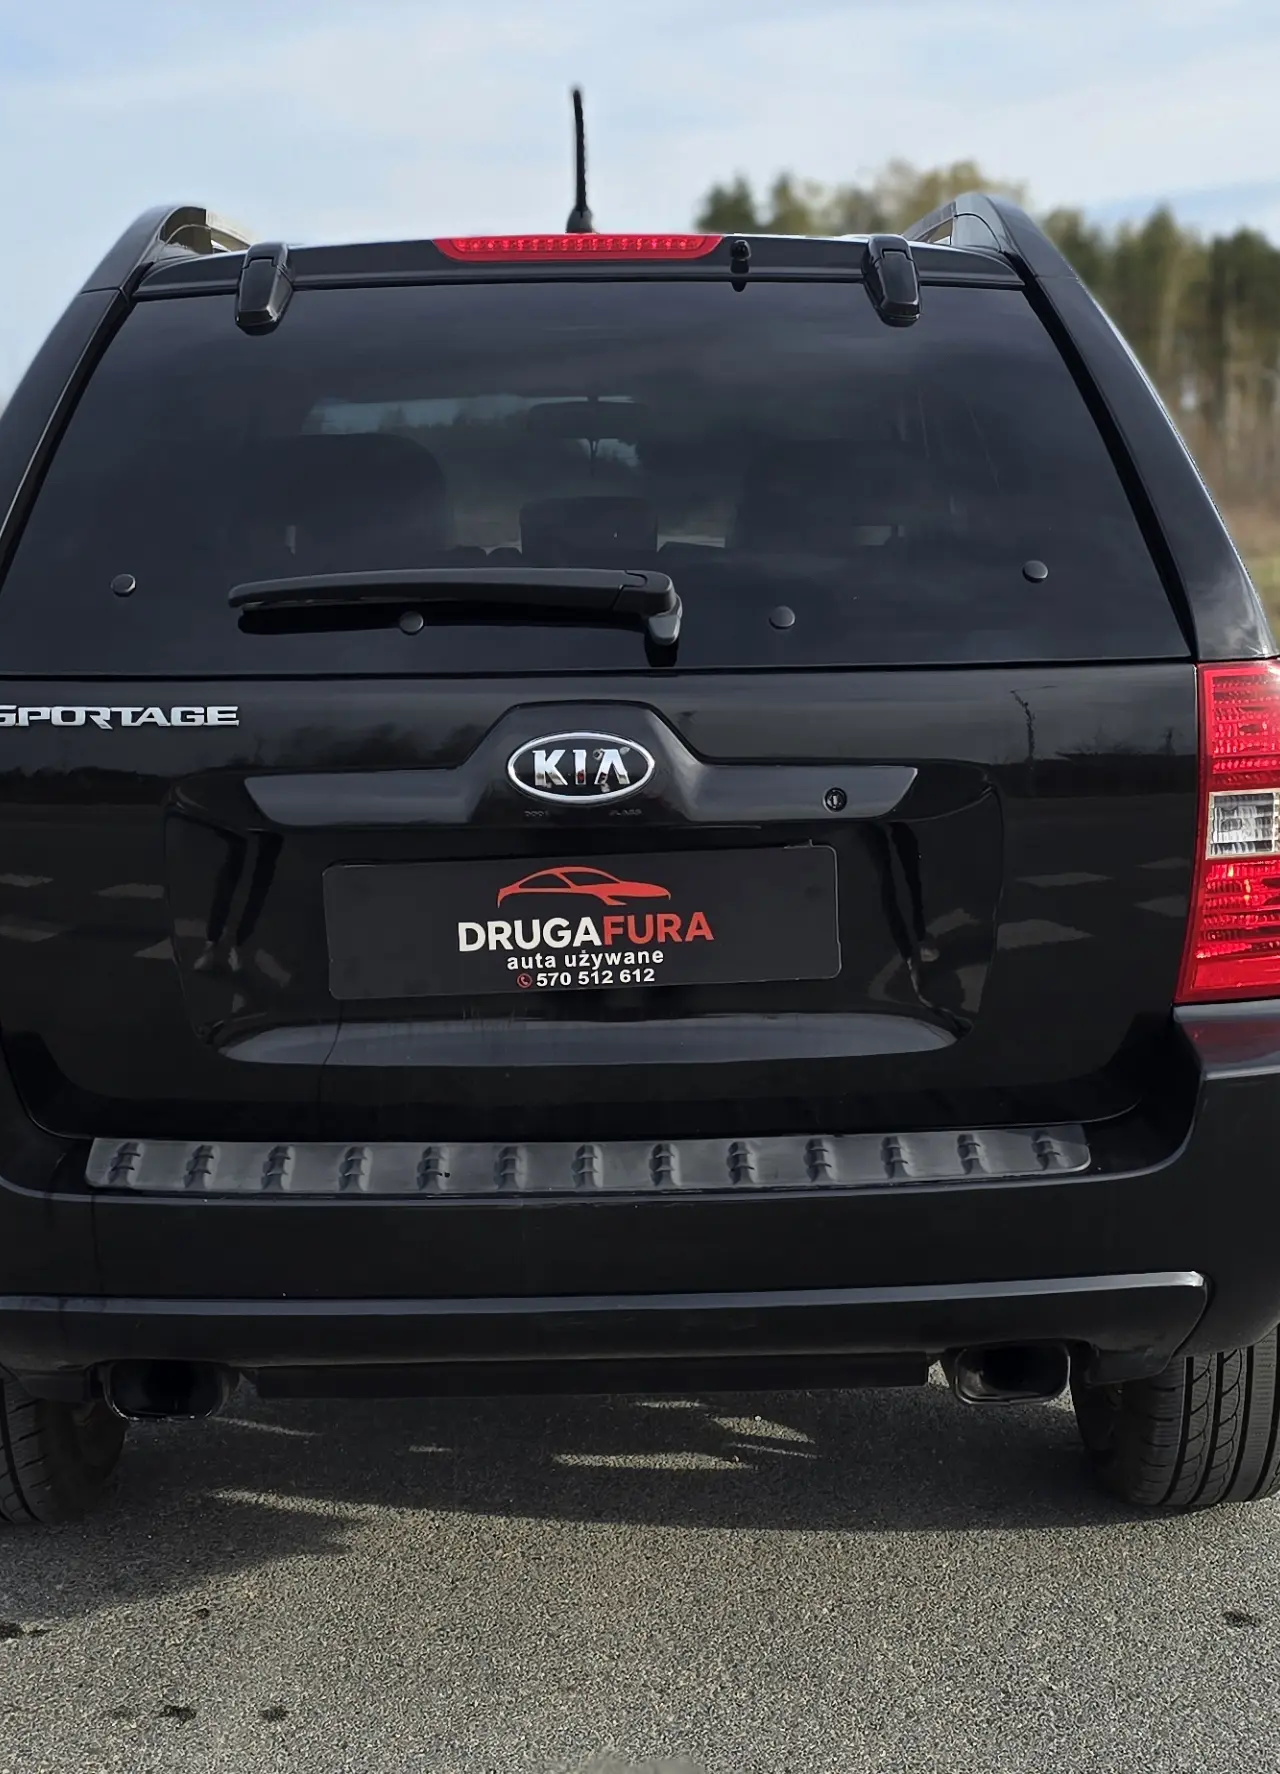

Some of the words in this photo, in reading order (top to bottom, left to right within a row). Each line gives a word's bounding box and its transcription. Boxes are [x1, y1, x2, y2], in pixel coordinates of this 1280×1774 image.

[532, 749, 631, 786] KIA
[458, 911, 715, 952] DRUGAFURA
[506, 953, 556, 970] auta
[564, 949, 665, 970] używane
[536, 972, 572, 987] 570
[578, 970, 614, 985] 512
[619, 968, 655, 983] 612
